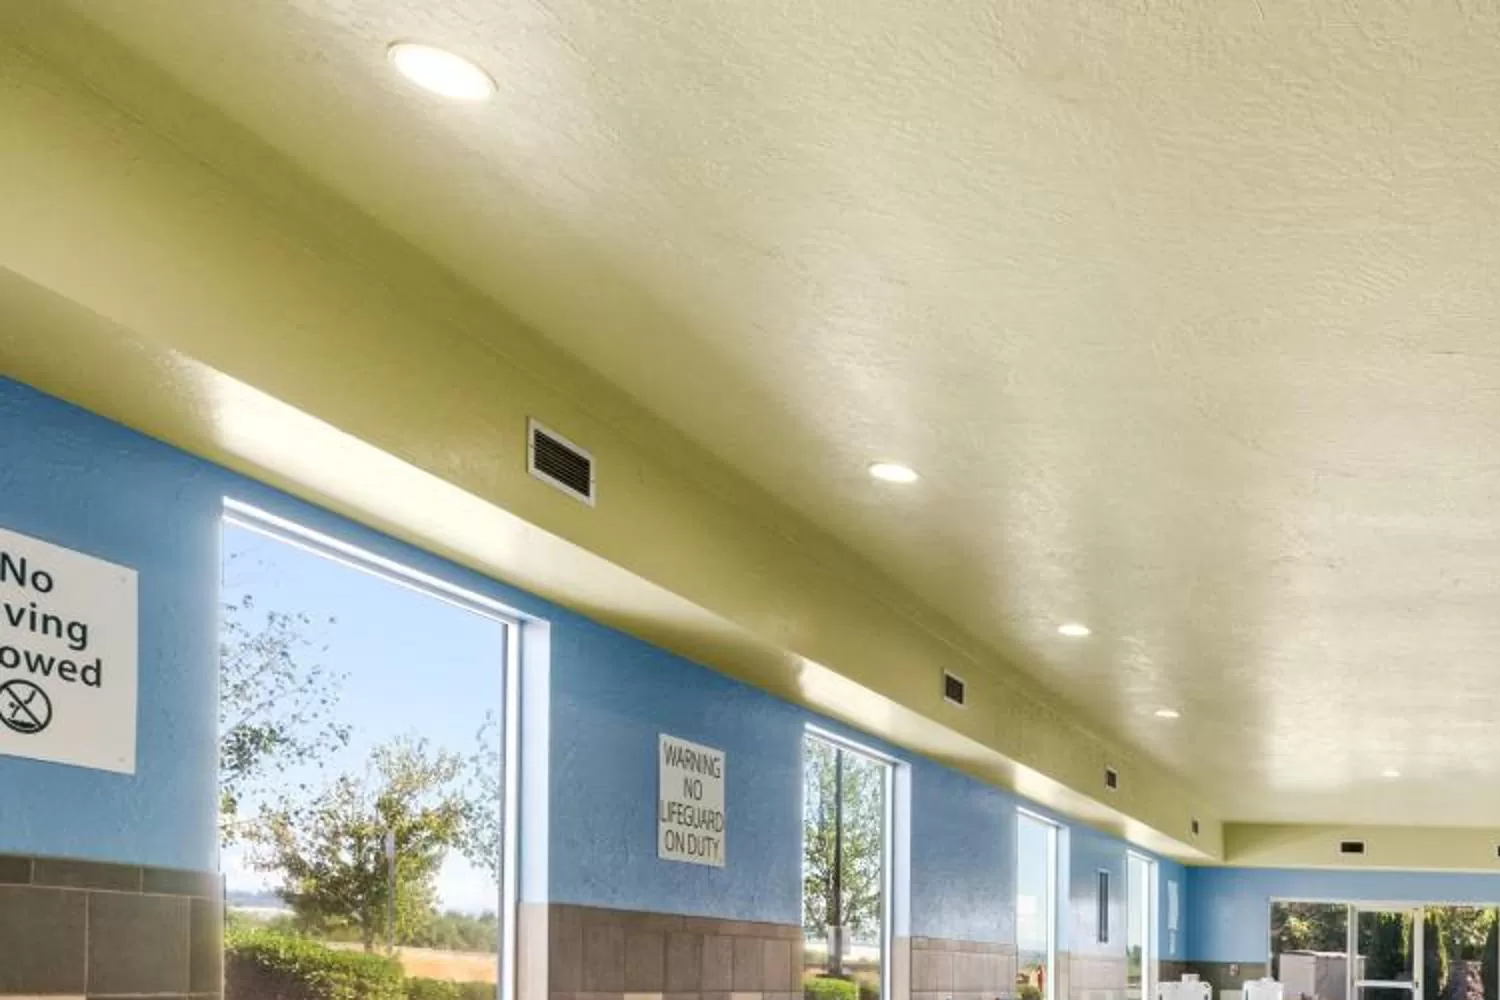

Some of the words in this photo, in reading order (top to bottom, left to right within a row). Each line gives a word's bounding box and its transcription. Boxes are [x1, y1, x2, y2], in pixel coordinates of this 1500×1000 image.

[0, 552, 53, 593] No
[4, 601, 88, 651] ving
[0, 645, 102, 688] owed
[663, 742, 721, 779] WARNING
[683, 777, 703, 801] NO
[660, 801, 724, 833] LIFEGUARD
[665, 829, 685, 853] ON
[688, 833, 721, 860] DUTY
